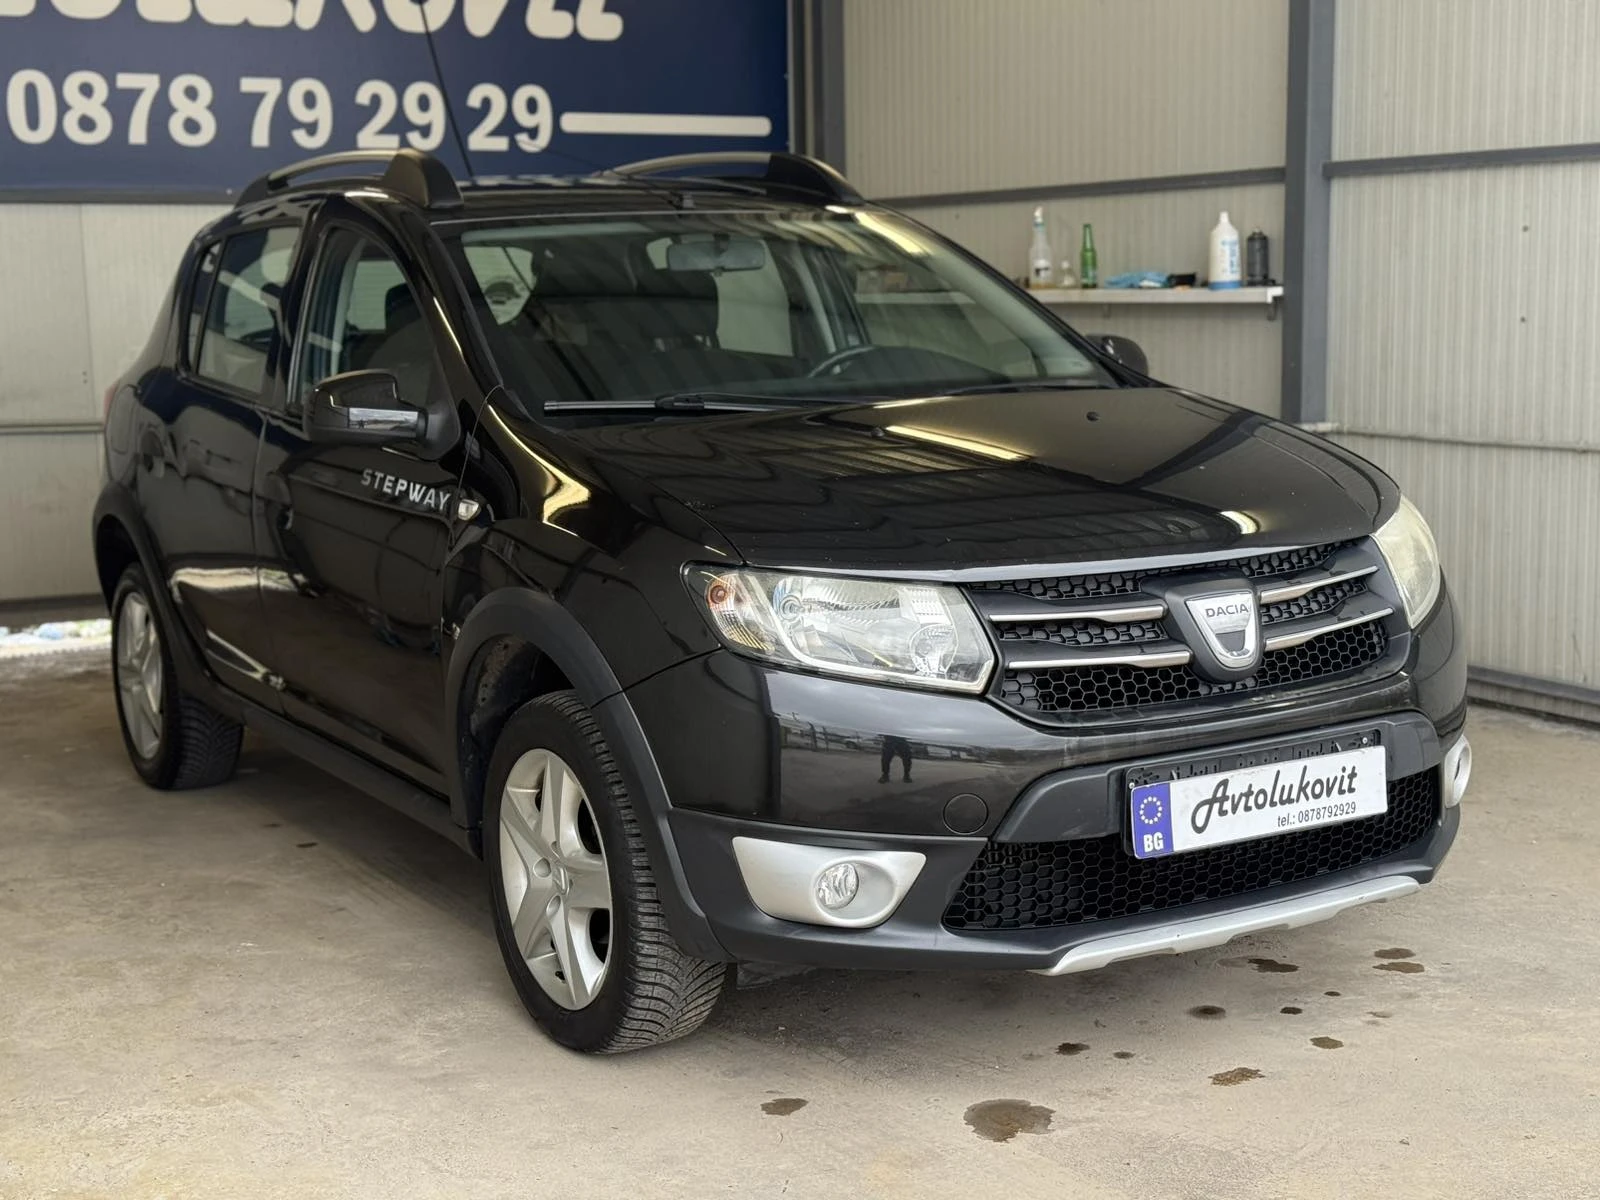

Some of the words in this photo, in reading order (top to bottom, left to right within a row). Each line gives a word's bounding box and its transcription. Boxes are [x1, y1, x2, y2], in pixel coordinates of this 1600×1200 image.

[6, 69, 217, 147] 0878
[239, 77, 333, 149] 79
[354, 80, 447, 151] 29
[466, 84, 554, 153] 29
[361, 468, 451, 510] STEPWAY
[1205, 603, 1249, 618] DACIA
[1190, 765, 1358, 834] Avtolukovit
[1276, 814, 1296, 828] tel.:
[1297, 801, 1357, 824] 0878792929
[1143, 832, 1164, 852] BG
